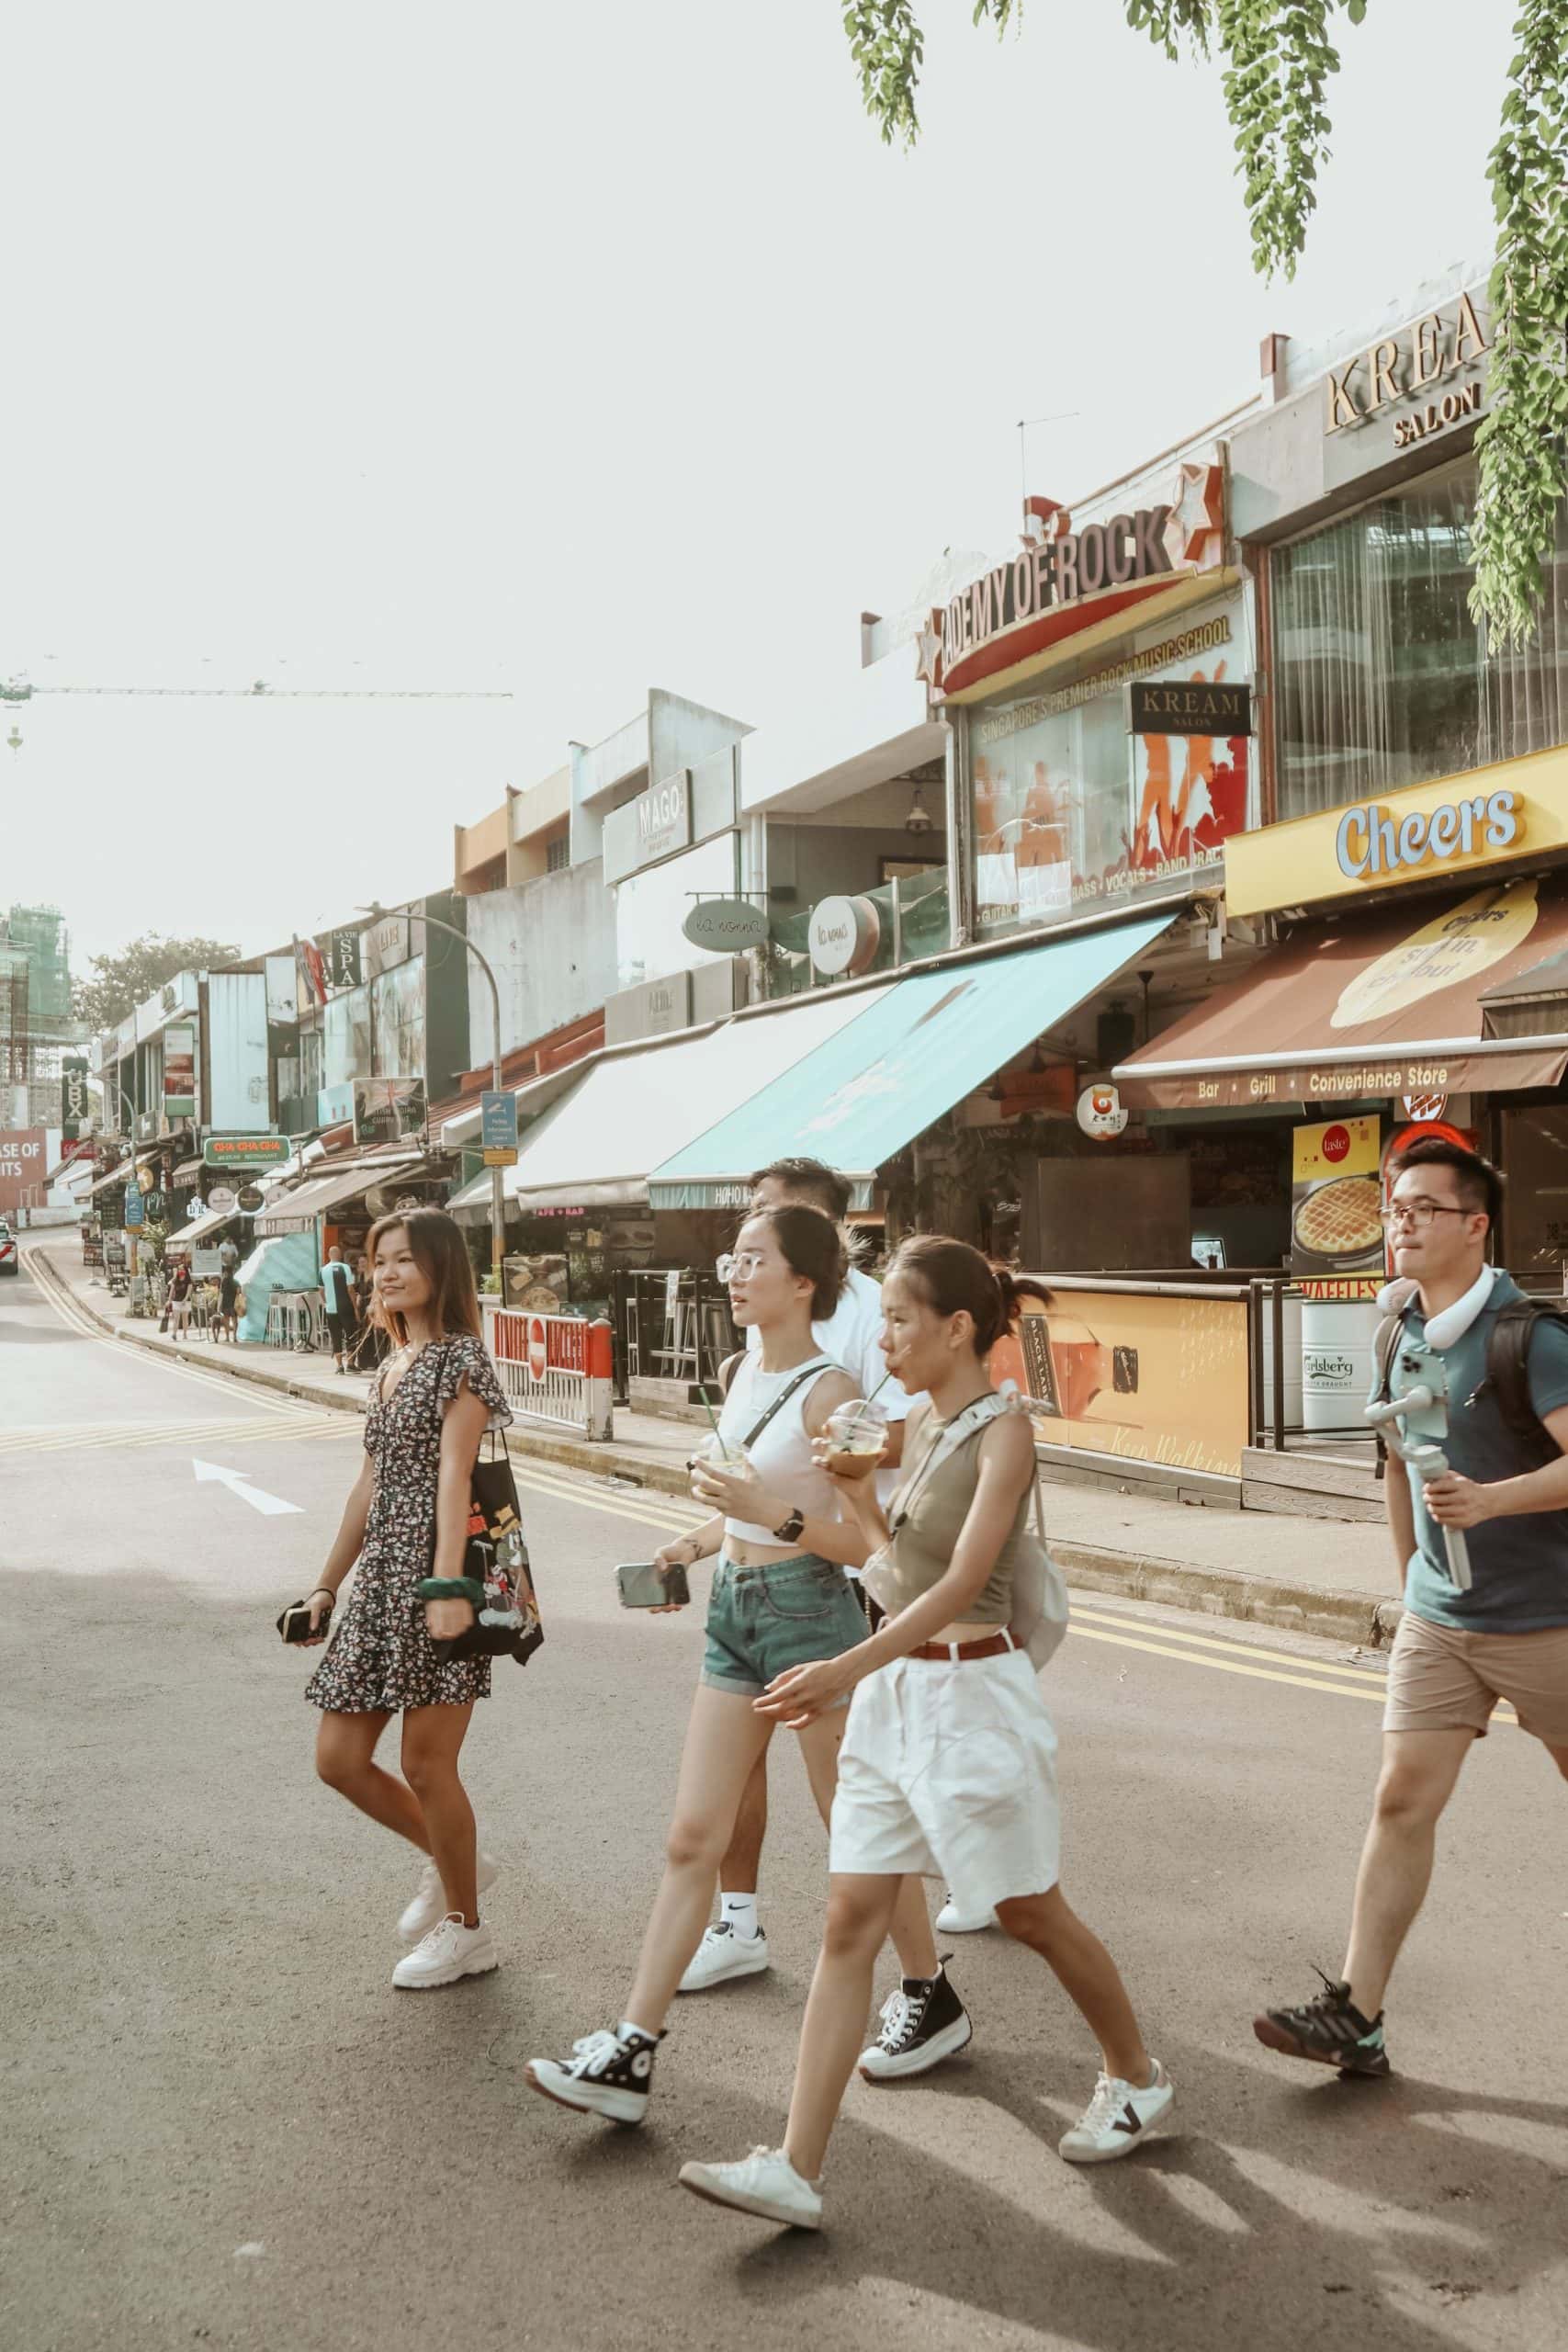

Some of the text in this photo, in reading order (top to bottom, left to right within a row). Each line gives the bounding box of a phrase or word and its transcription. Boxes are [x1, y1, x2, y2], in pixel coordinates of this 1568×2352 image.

[1392, 382, 1481, 448] SALON
[1012, 544, 1049, 618] OF
[1056, 504, 1174, 603] ROCK
[1049, 675, 1098, 714] PREMIER
[1100, 661, 1132, 692] ROCK
[1132, 640, 1176, 677] MUSIC
[1175, 615, 1233, 659] SCHOOL
[1142, 690, 1241, 715] KREAM
[1173, 718, 1212, 727] SALON
[1337, 790, 1521, 879] Cheers
[1106, 866, 1146, 892] VOCALS
[1156, 856, 1188, 876] BAND
[339, 938, 355, 985] SPA
[1198, 1066, 1448, 1099] Bar Grill Convenience Store
[0, 1142, 39, 1158] SE OF
[1297, 1279, 1377, 1299] WAFFLES
